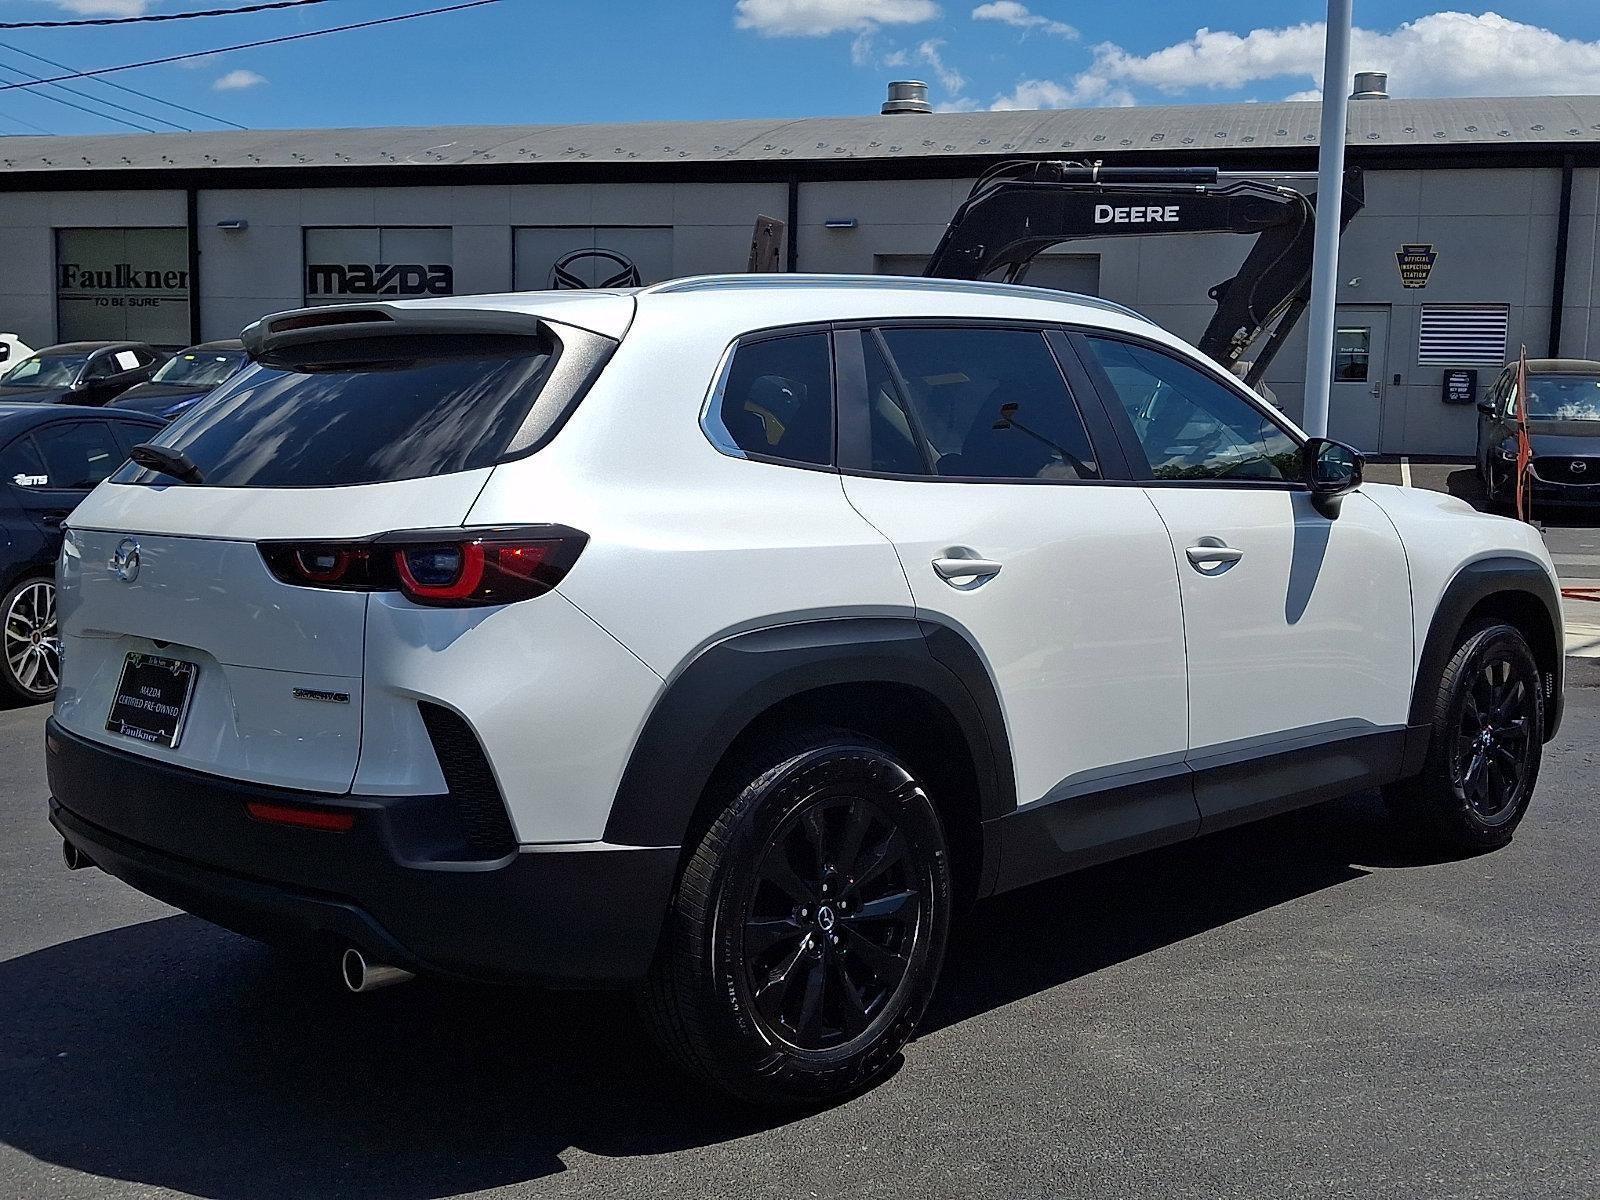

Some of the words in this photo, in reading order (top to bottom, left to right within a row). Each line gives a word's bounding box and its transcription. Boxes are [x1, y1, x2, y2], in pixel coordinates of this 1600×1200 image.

[1094, 204, 1180, 224] DEERE
[60, 264, 188, 288] Faulkner
[94, 298, 109, 307] TO
[111, 298, 125, 307] BE
[128, 298, 161, 307] SURE
[140, 686, 161, 698] MAZDA
[118, 695, 143, 708] CERTIFIED
[143, 701, 178, 716] PRE-OWNED
[120, 725, 157, 741] Faulkner
